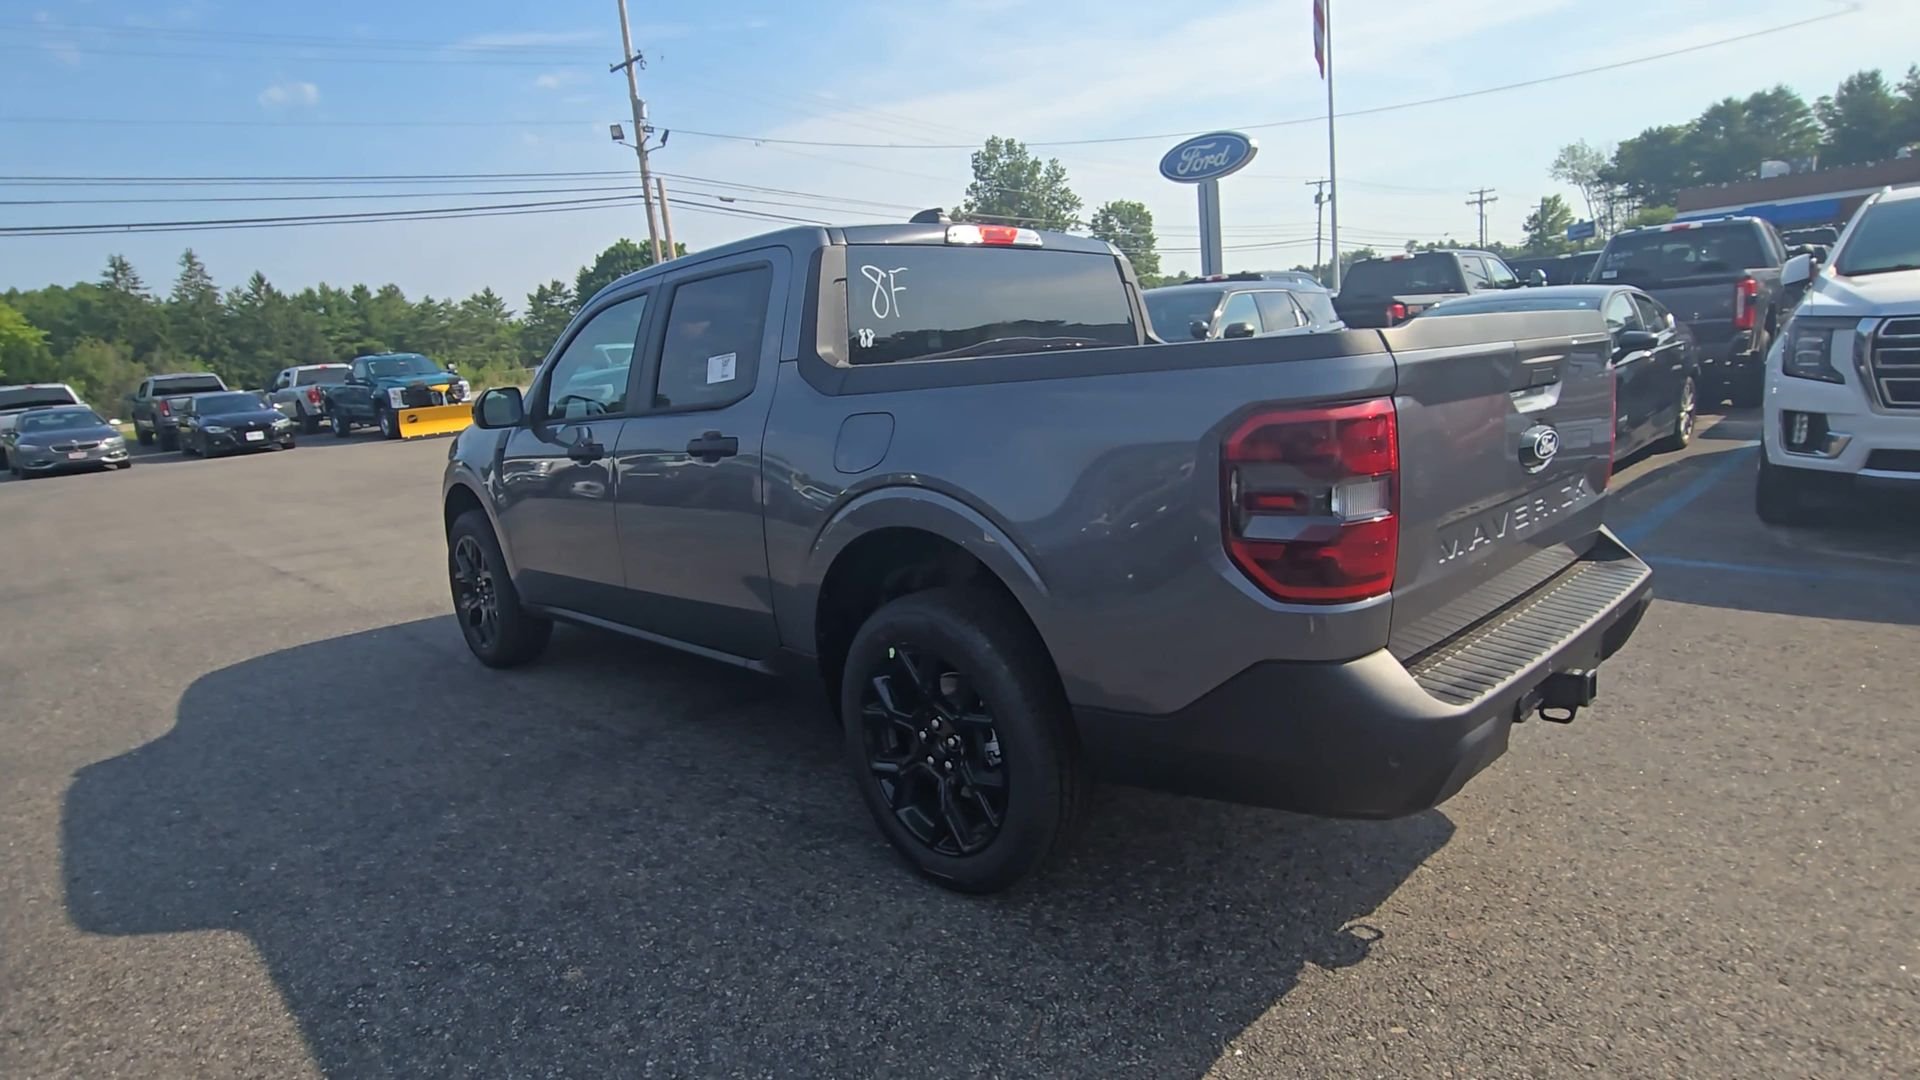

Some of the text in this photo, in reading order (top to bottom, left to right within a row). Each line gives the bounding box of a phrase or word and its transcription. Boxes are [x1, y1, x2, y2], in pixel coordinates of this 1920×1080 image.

[1177, 142, 1231, 174] Ford
[861, 265, 909, 319] 8F
[1438, 478, 1587, 564] MAVERCK
